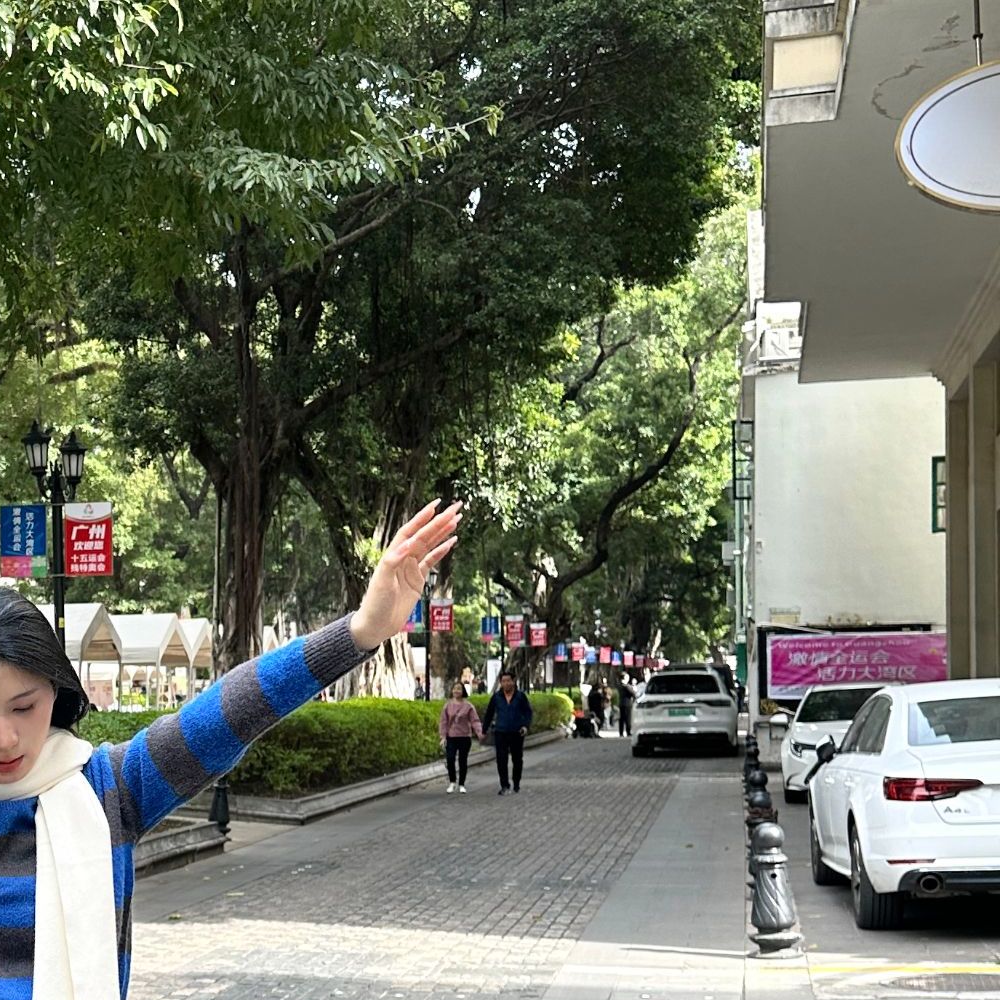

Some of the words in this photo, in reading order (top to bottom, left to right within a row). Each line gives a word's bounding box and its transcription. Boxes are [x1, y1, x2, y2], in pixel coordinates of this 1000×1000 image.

[71, 524, 106, 540] 广州
[73, 540, 104, 551] 欢迎您
[70, 553, 106, 562] 十五运会
[70, 563, 106, 572] 残特奥会
[817, 665, 917, 681] 活力大湾区
